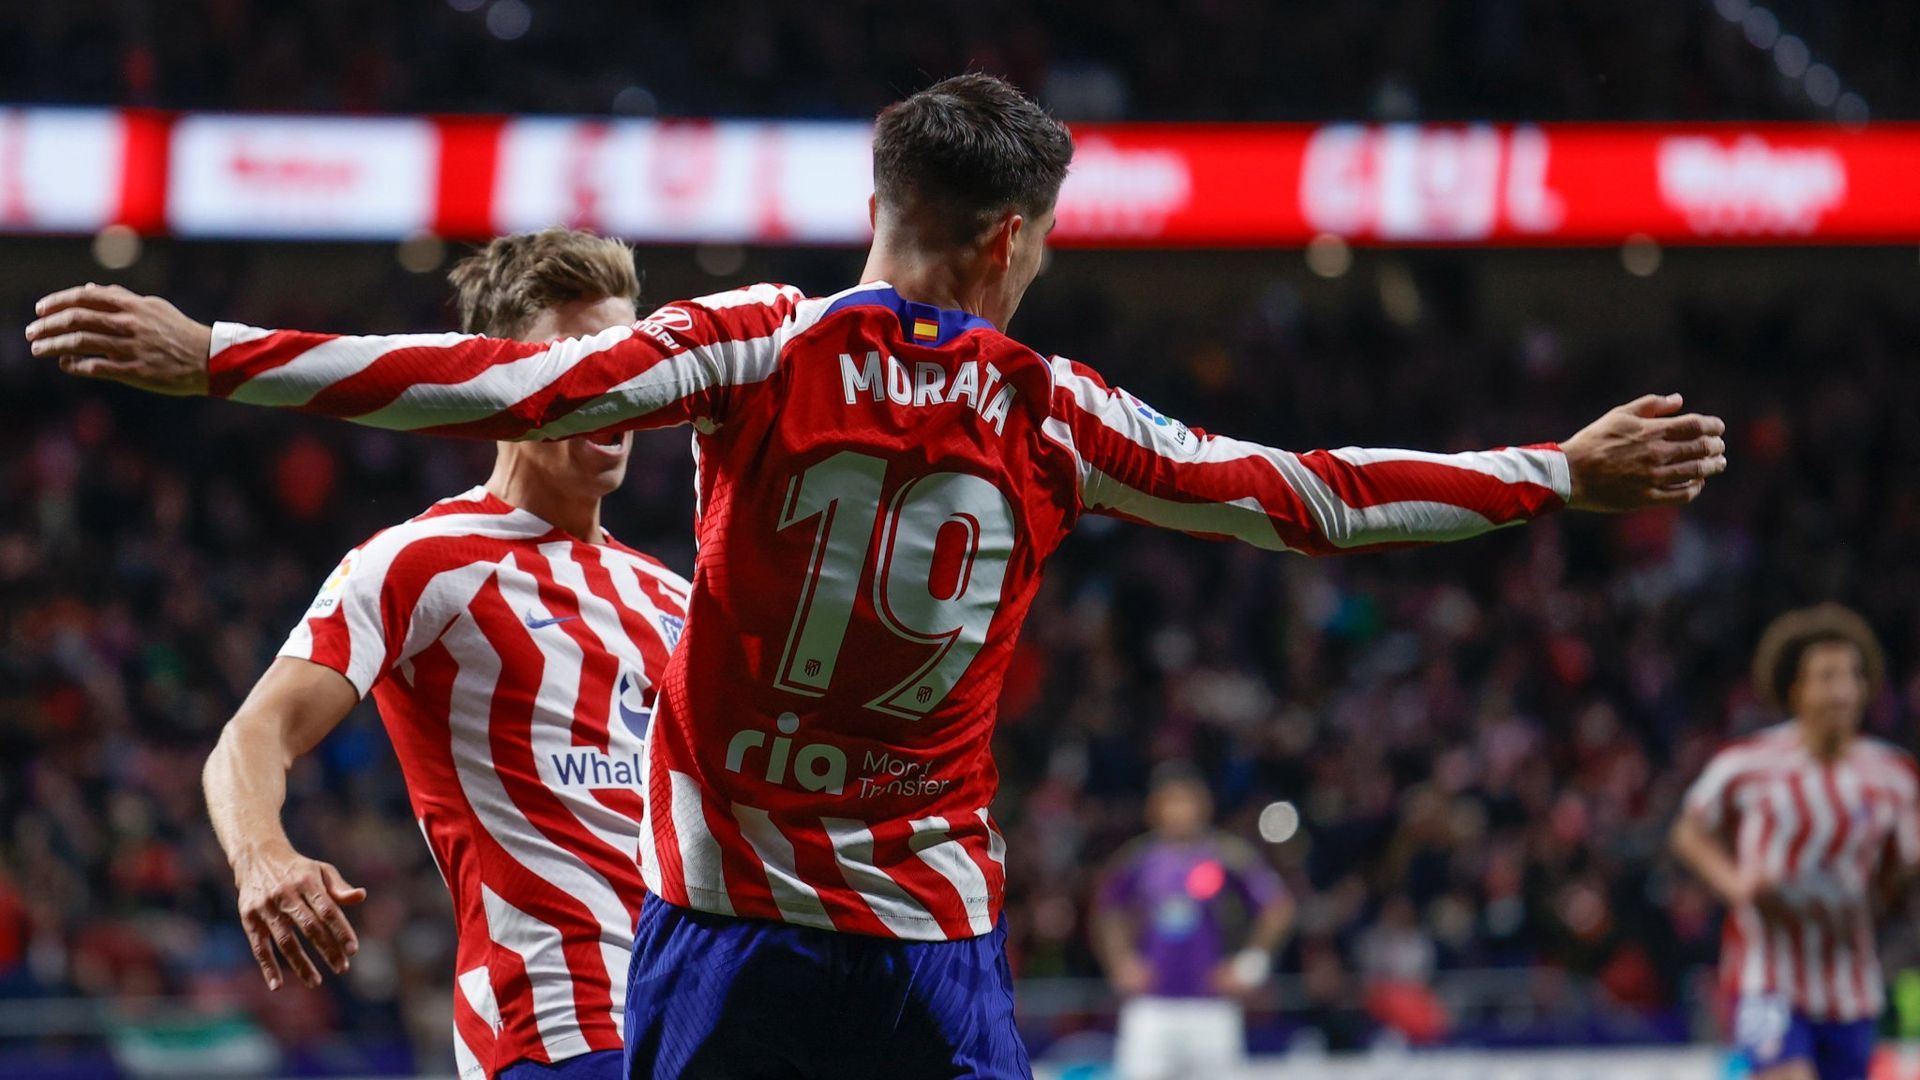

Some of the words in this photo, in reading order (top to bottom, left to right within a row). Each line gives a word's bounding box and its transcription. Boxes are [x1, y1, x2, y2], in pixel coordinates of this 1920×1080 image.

[839, 350, 1018, 438] MORATA
[773, 450, 1016, 722] 19
[725, 711, 848, 796] ria
[857, 773, 950, 799] Trnsfer
[863, 750, 934, 777] Mony
